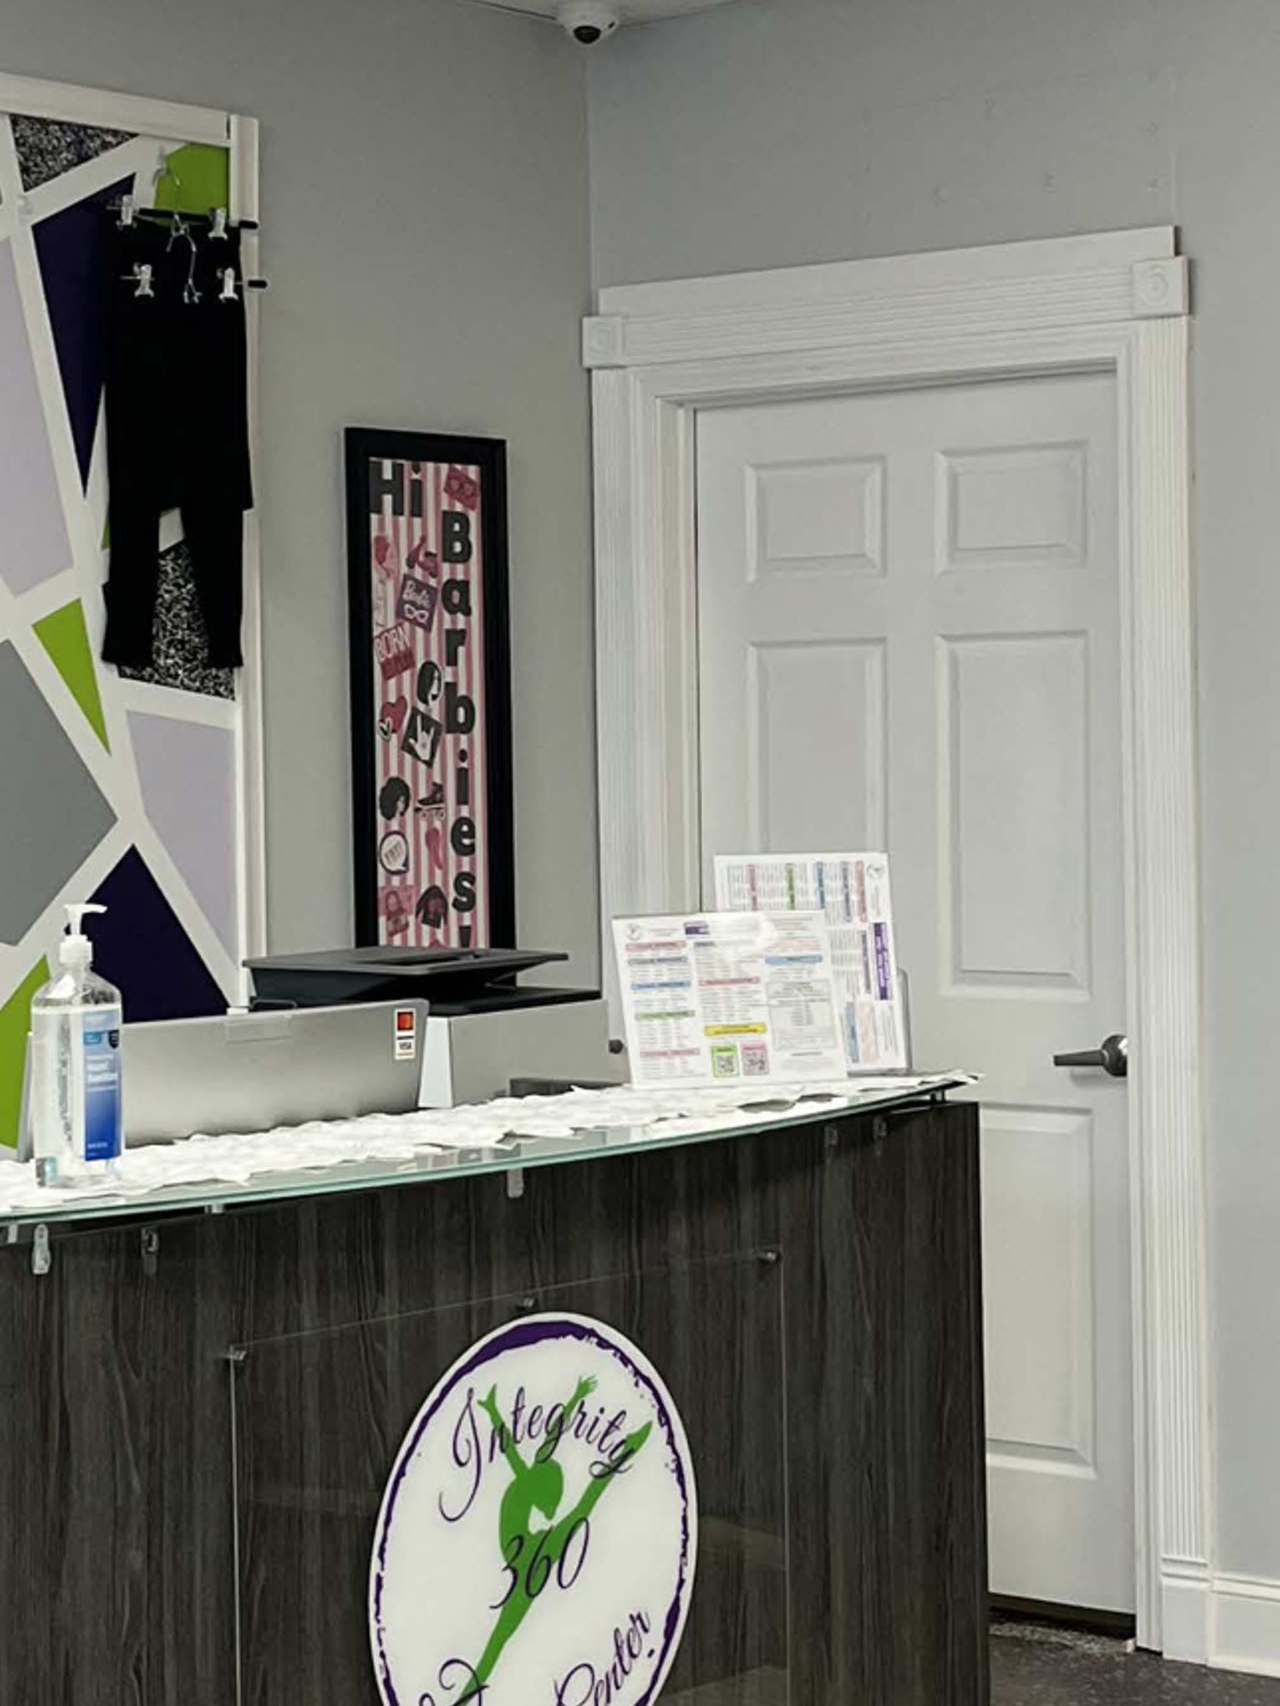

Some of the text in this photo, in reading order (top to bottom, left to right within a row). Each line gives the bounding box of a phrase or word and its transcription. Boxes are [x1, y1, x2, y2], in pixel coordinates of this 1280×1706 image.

[370, 459, 424, 517] Hi
[438, 1386, 636, 1522] Integrity
[489, 1516, 590, 1610] 360
